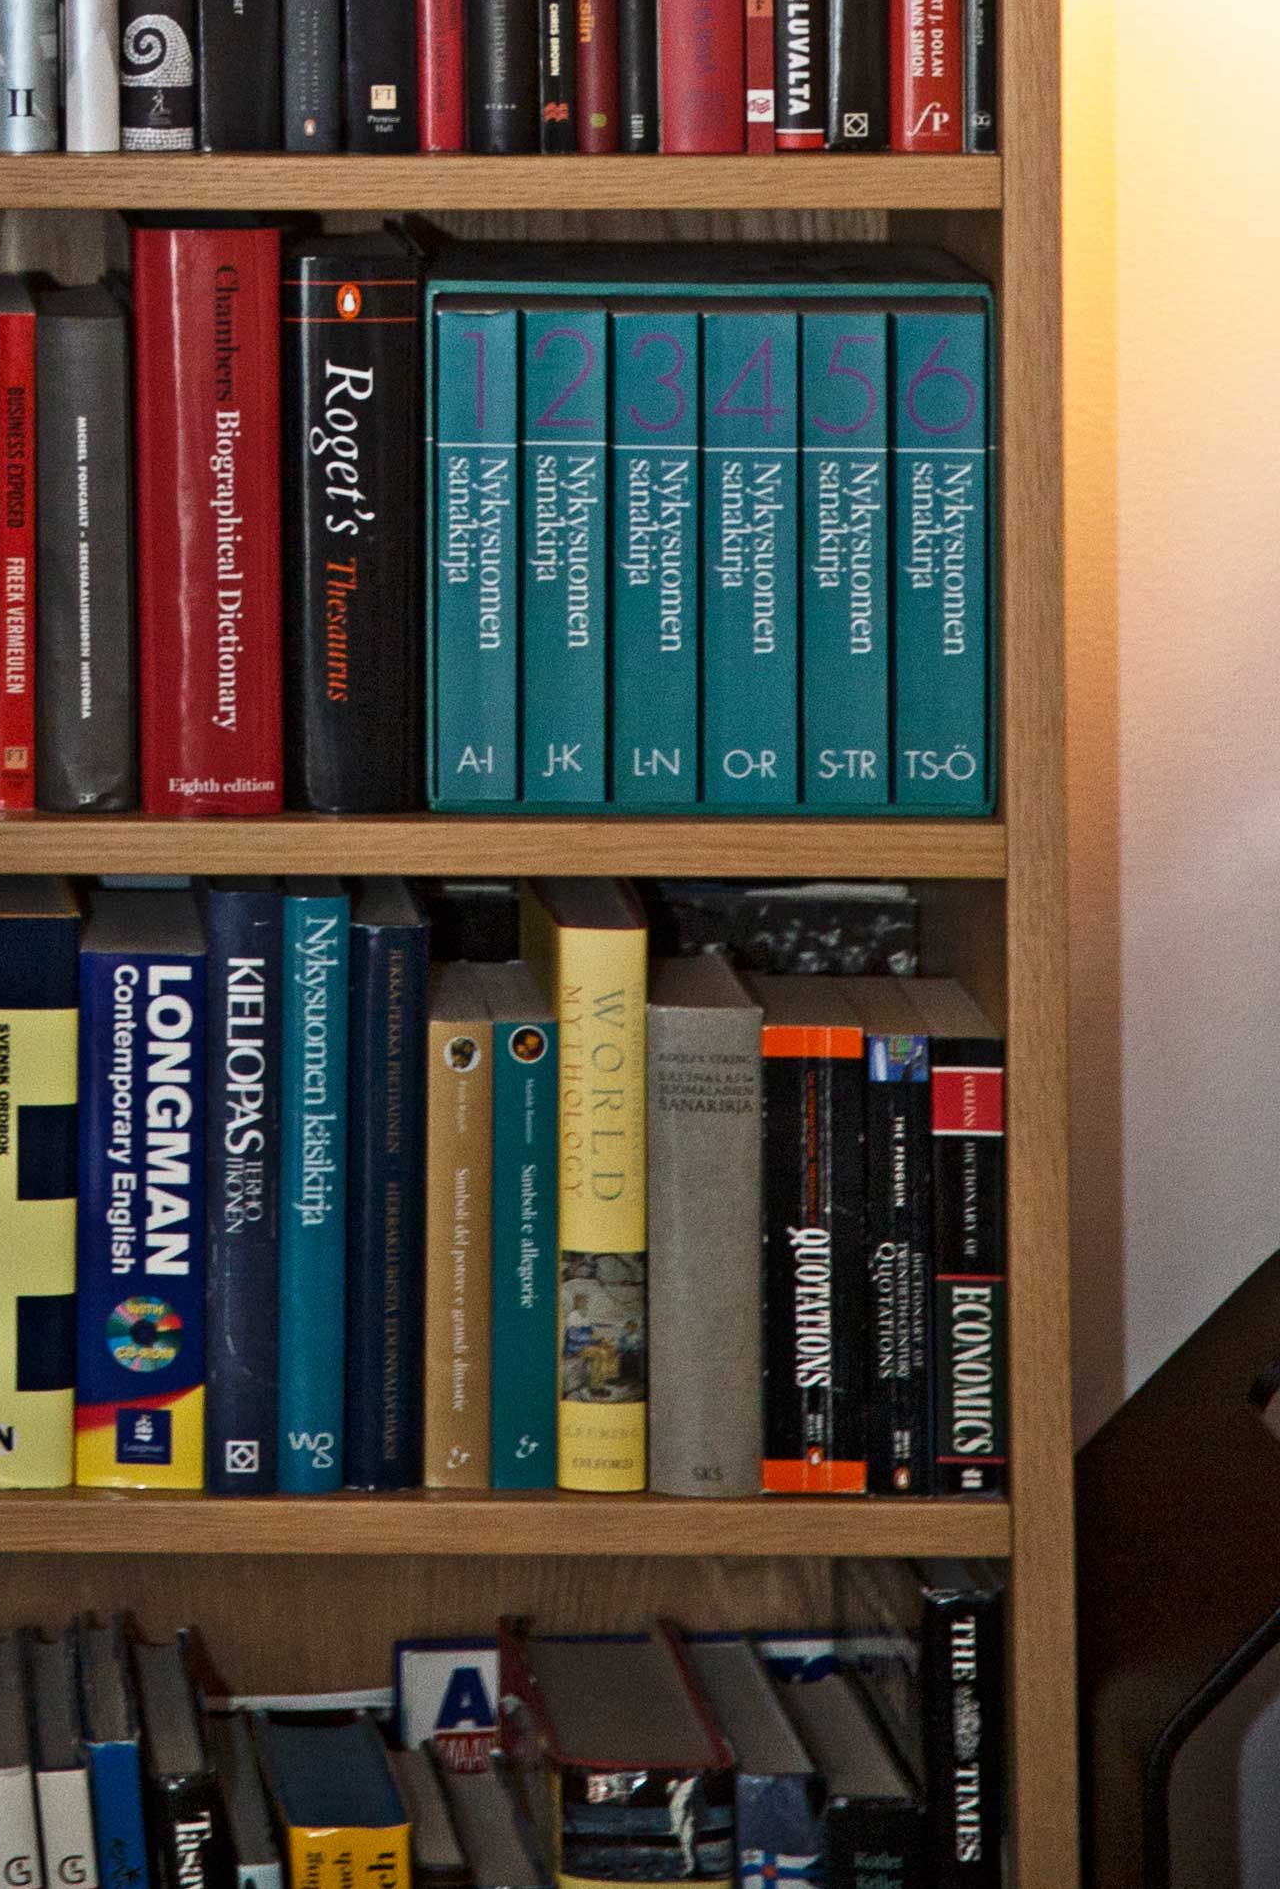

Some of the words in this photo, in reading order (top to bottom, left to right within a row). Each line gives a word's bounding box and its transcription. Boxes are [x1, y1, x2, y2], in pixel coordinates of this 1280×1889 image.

[211, 410, 241, 581] Biographical
[310, 360, 374, 535] Roget's
[905, 462, 935, 589] sanakirja
[326, 558, 356, 702] Thesaurus
[934, 462, 974, 654] Nykysuomen
[213, 589, 243, 731] Dictionary
[108, 965, 136, 1162] Contemporary
[226, 957, 264, 1154] KIELIOPAS
[298, 916, 337, 1104] Nykysuomen
[146, 965, 190, 1275] LONGMAN
[294, 1113, 333, 1225] käsikirja
[108, 1173, 135, 1274] English
[786, 1227, 831, 1387] QUOTATIONS
[952, 1286, 992, 1454] ECONOMICS
[954, 1615, 979, 1682] THE
[955, 1761, 980, 1864] TIMES
